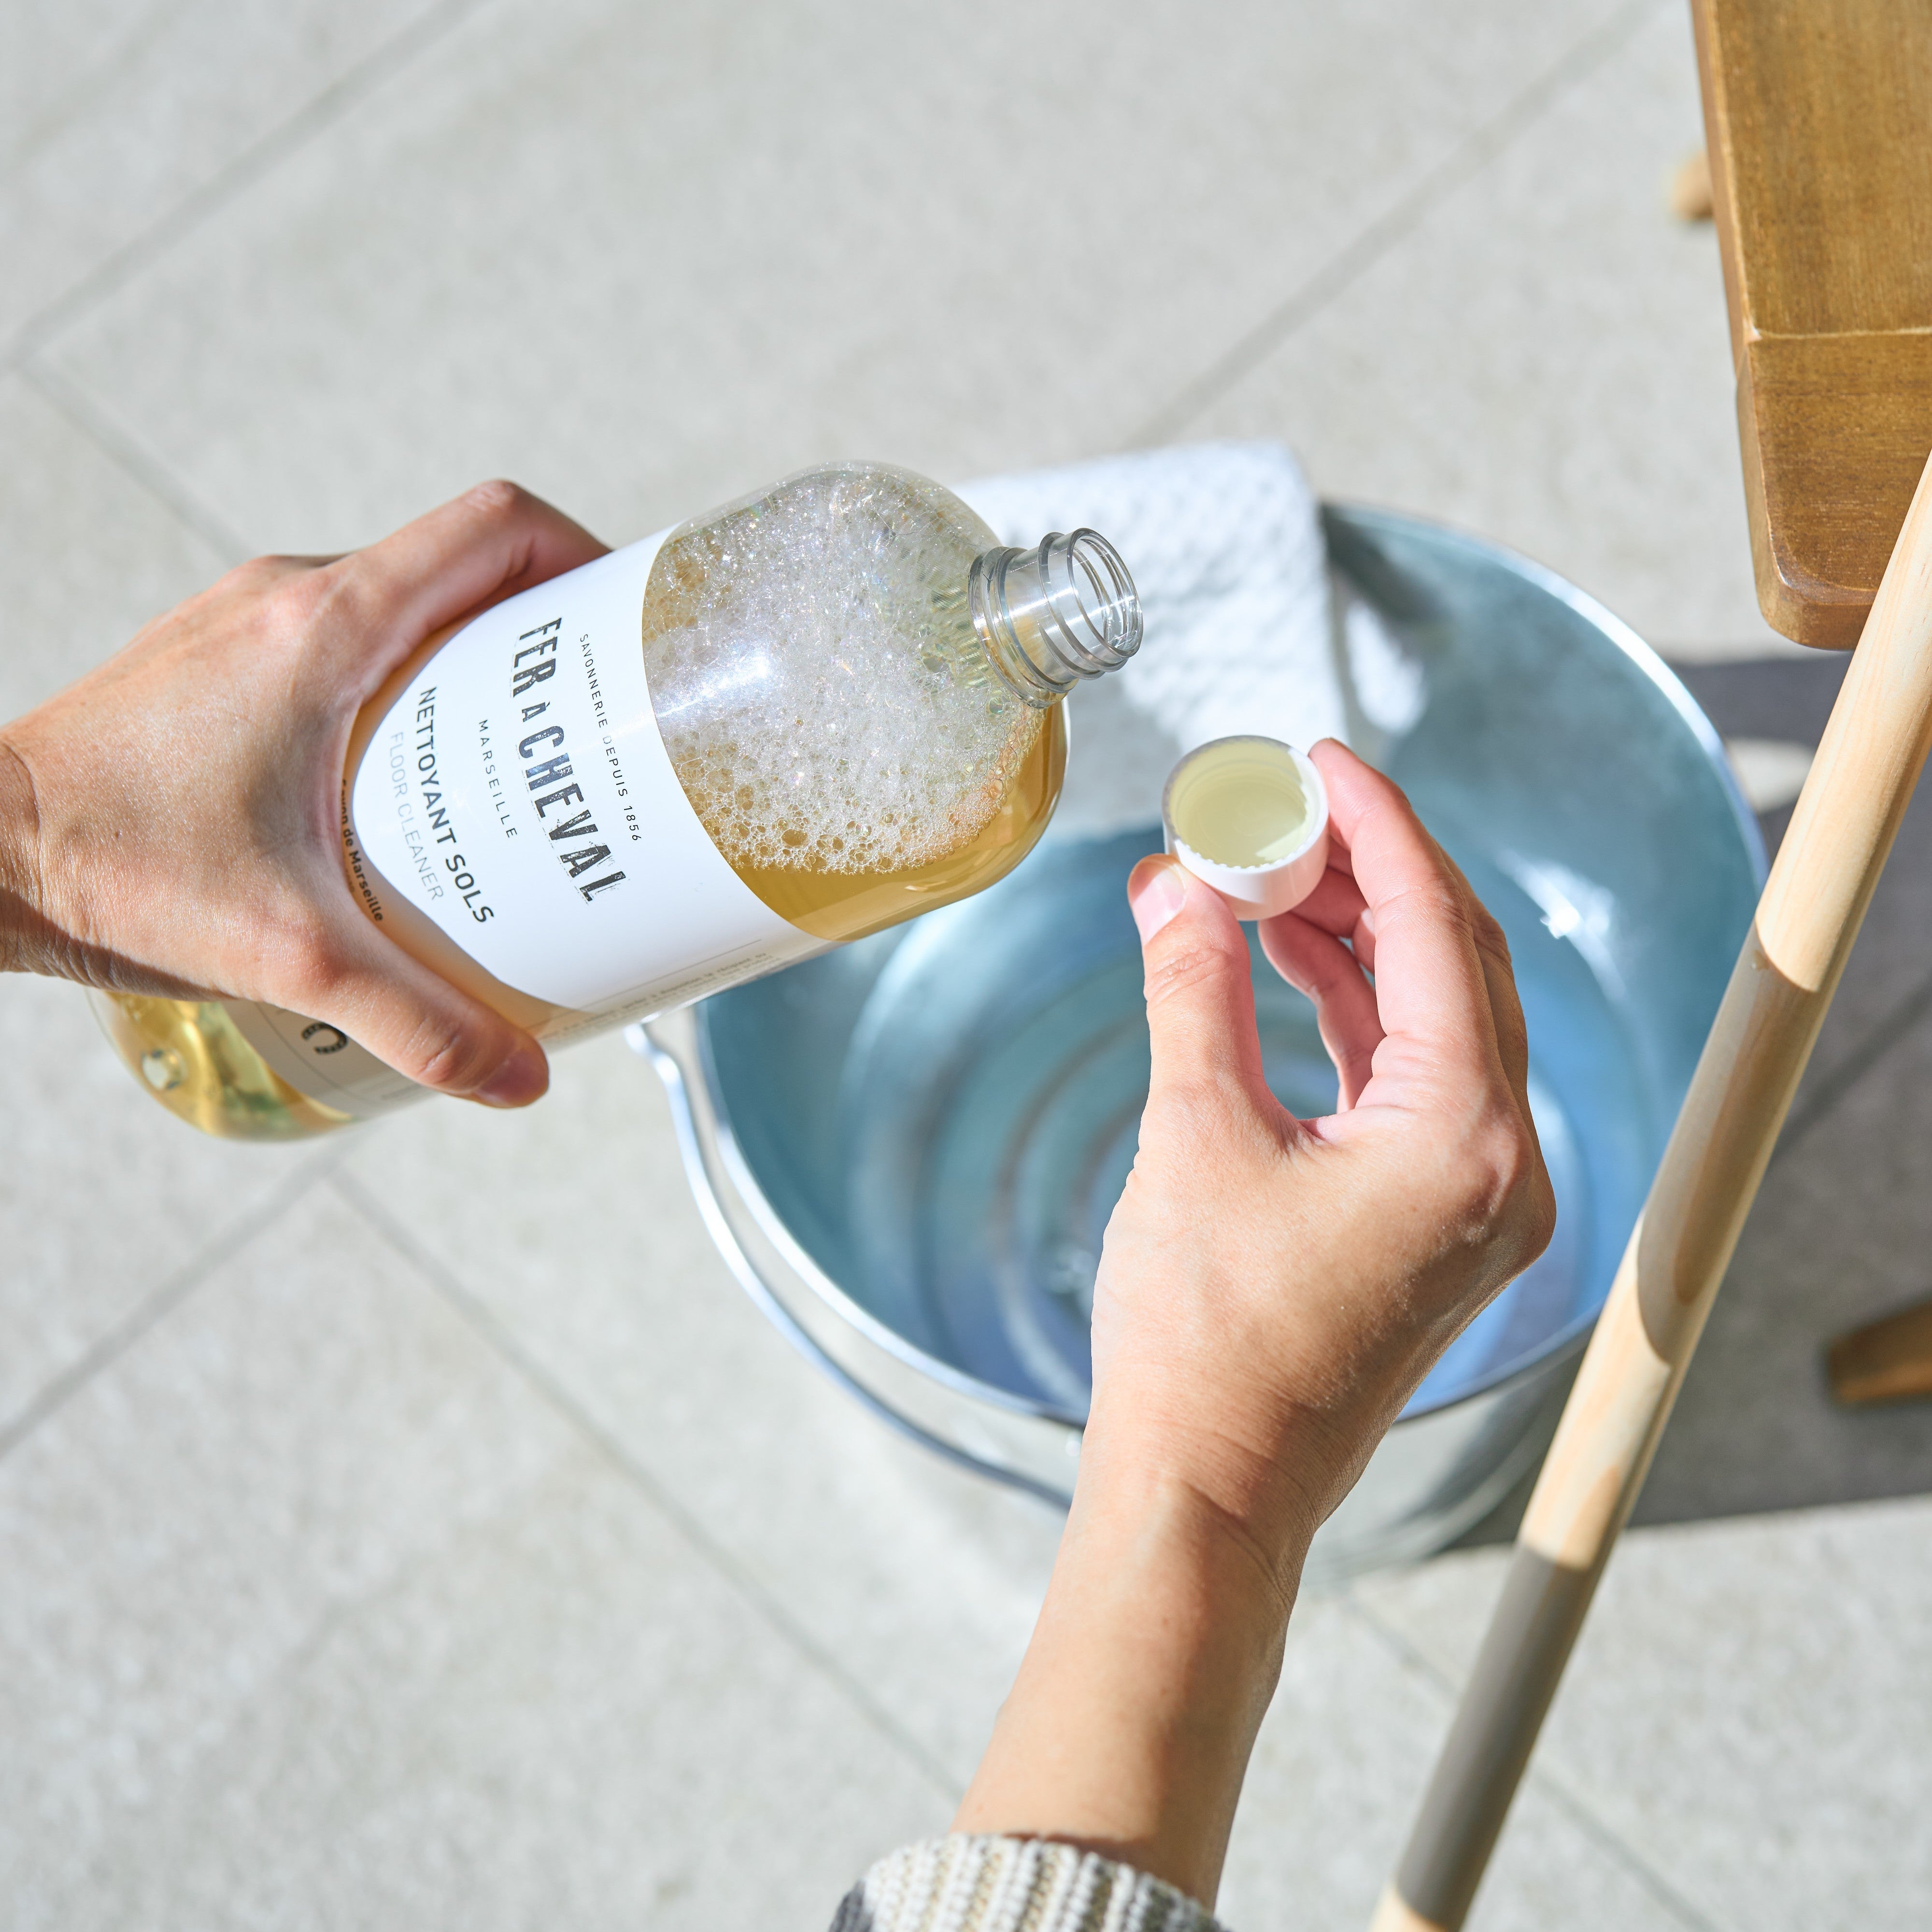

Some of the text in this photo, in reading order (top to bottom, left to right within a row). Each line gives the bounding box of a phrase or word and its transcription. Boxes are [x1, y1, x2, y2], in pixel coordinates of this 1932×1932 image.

[389, 730, 444, 901] FLOOR CLEANER
[416, 686, 495, 923] NETTOYANT SOLS
[478, 719, 518, 838] MARSEILLE
[512, 617, 626, 902] FER À CHEVAL
[580, 634, 642, 841] SAVONNERIE DEPUIS 1856
[343, 827, 354, 847] de
[348, 850, 384, 922] Marseille
